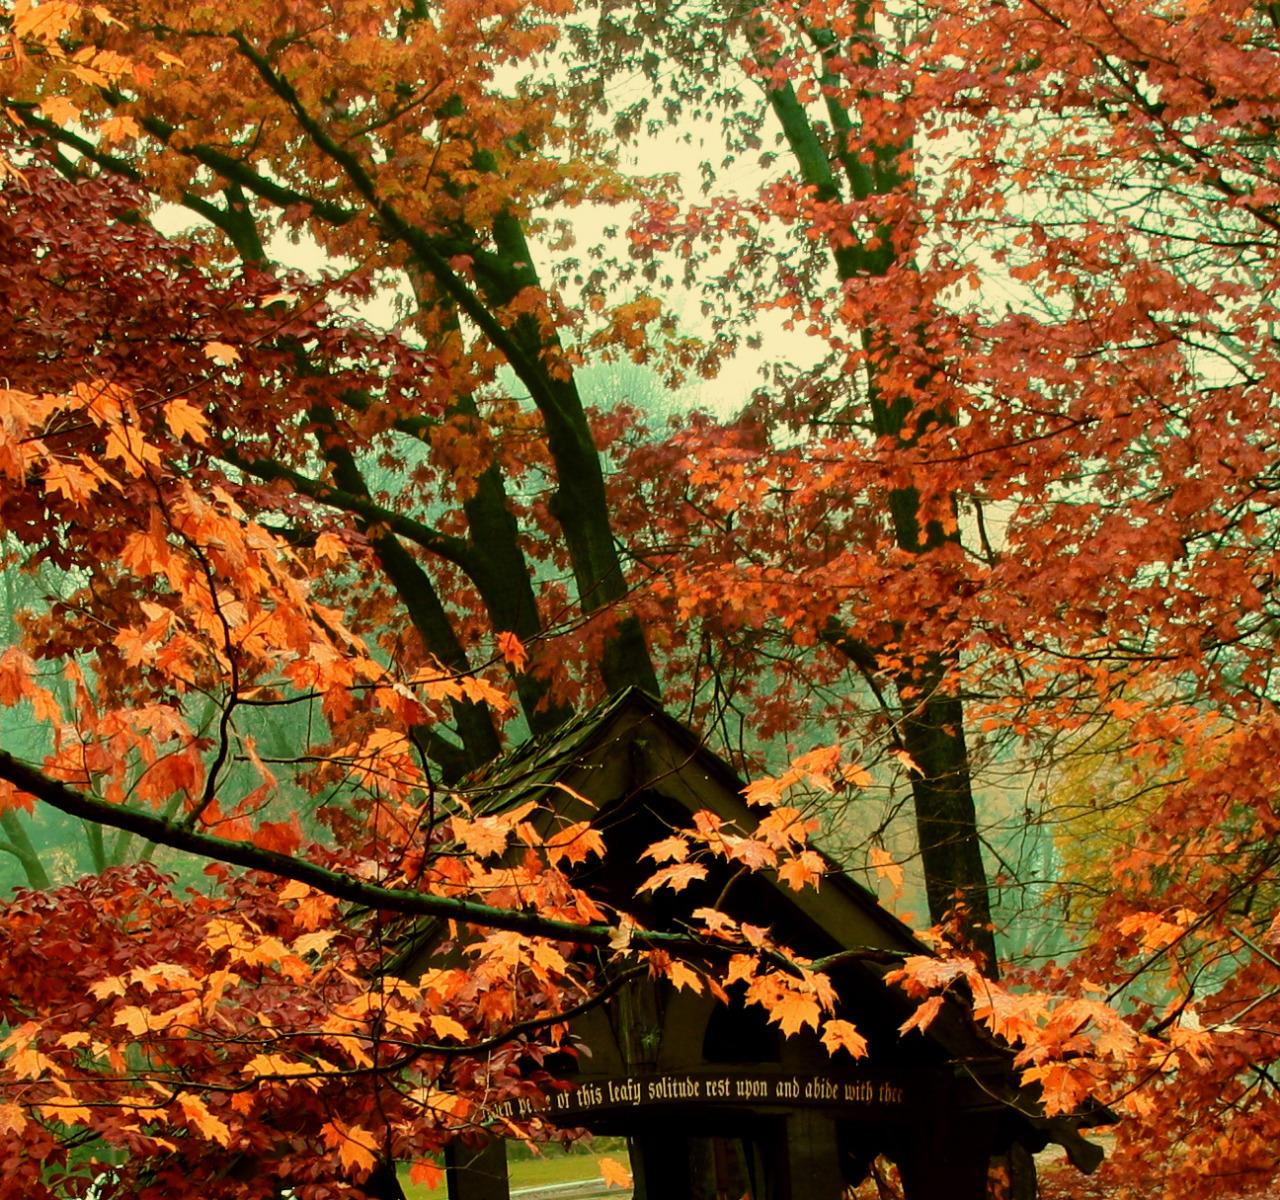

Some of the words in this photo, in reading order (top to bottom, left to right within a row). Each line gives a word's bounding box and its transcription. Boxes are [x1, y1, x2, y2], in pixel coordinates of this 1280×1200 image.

[518, 1094, 551, 1119] pee
[557, 1090, 570, 1109] of
[577, 1083, 602, 1109] this
[608, 1079, 641, 1105] leafy
[648, 1076, 699, 1100] solitude
[706, 1077, 730, 1098] rest
[736, 1078, 768, 1100] upon
[776, 1076, 800, 1098] and
[805, 1076, 838, 1099] abide
[844, 1080, 873, 1105] with
[879, 1081, 903, 1105] thee
